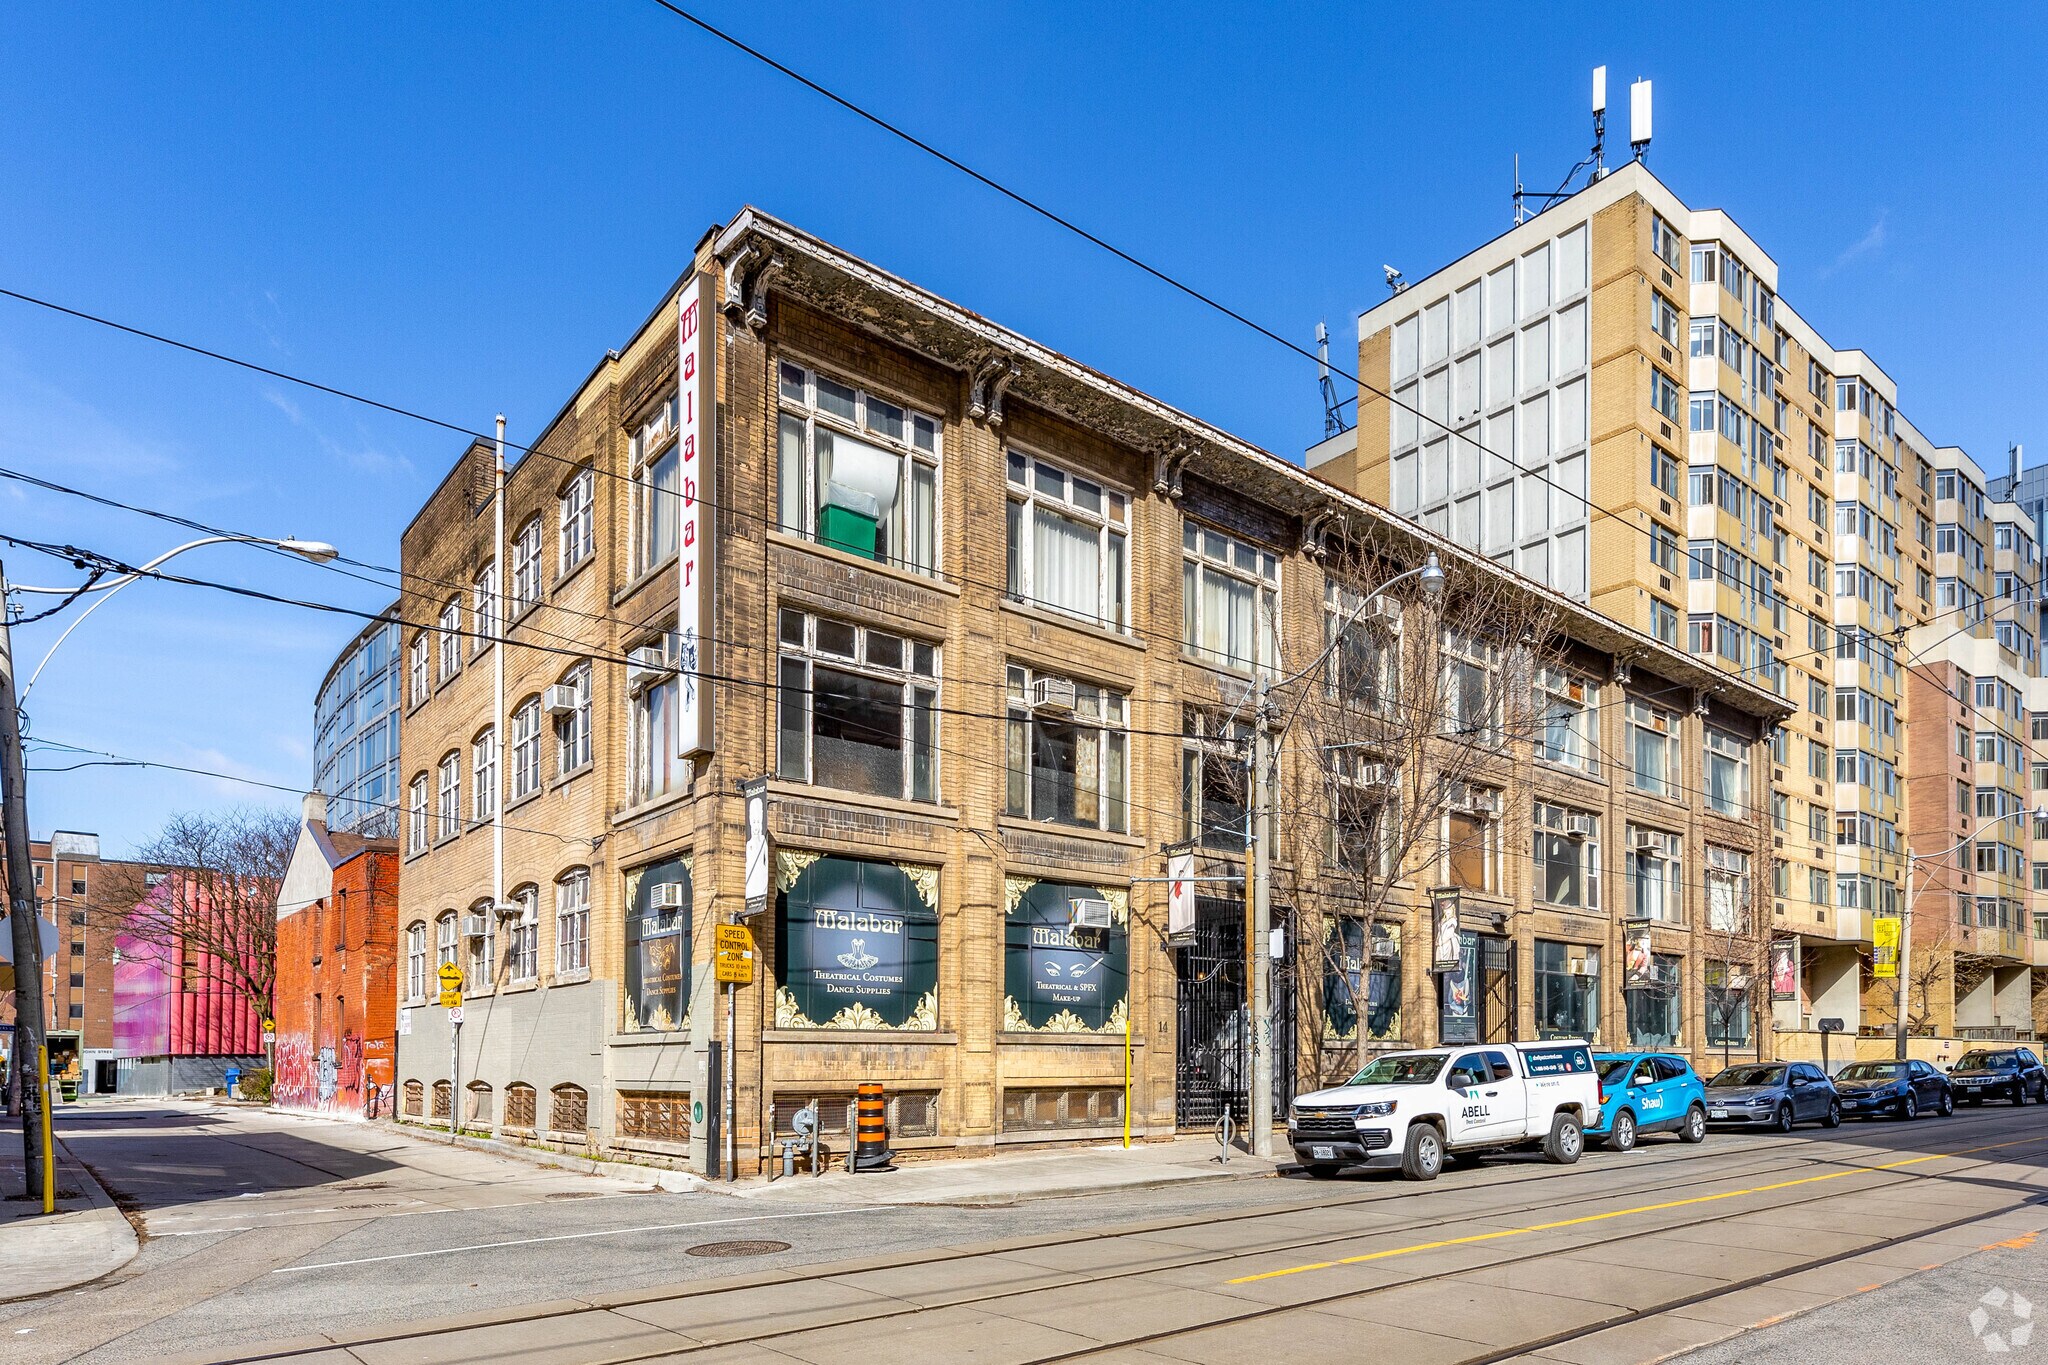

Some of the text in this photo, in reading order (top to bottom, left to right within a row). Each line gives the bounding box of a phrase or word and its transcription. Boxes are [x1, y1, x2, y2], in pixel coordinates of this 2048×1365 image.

[681, 299, 698, 587] Malabar
[642, 913, 682, 937] Malabar
[815, 909, 903, 934] Malabar
[724, 929, 745, 939] SPEED
[1032, 927, 1100, 949] Malabar
[720, 940, 749, 951] CONTROL
[727, 952, 744, 961] ZONE
[1080, 983, 1097, 992] SPFX
[1158, 1021, 1168, 1033] 14
[1461, 1105, 1490, 1119] ABELL
